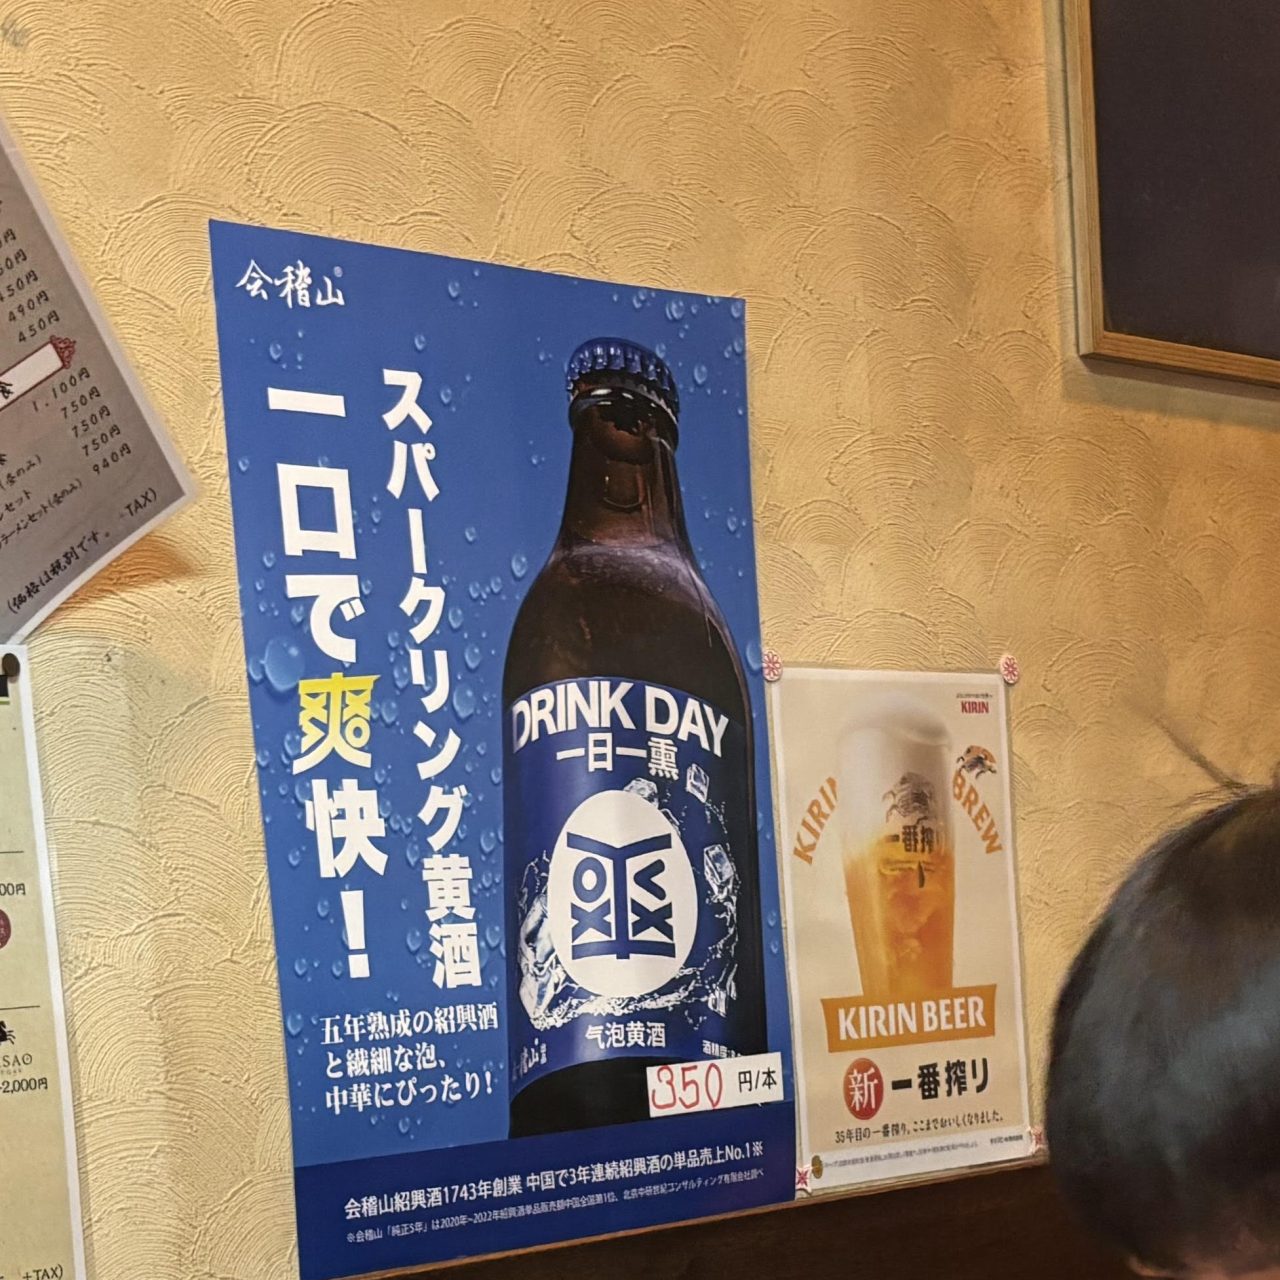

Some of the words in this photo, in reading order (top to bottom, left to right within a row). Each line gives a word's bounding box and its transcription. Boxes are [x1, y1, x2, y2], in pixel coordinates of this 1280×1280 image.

[9, 290, 49, 322] 490円
[19, 310, 60, 343] 450円
[61, 386, 101, 419] 750円
[72, 405, 111, 438] 750円
[82, 424, 121, 457] 750円
[93, 443, 131, 475] 940円
[266, 386, 389, 979] 一口で爽快！
[381, 368, 483, 989] スパークリング黄酒
[511, 679, 636, 755] DRINK
[644, 681, 730, 758] DAY
[961, 701, 989, 714] KIRIN
[953, 769, 1003, 854] BREW
[320, 1001, 498, 1045] 五年熟成の紹興酒
[585, 1021, 667, 1050] 气泡黄酒
[837, 1001, 918, 1041] KIRIN
[924, 995, 987, 1034] BEER
[326, 1041, 446, 1079] と繊細な泡、
[651, 1062, 723, 1110] 350
[738, 1067, 777, 1093] 円/本
[848, 1066, 879, 1112] 新
[891, 1056, 989, 1101] 一番搾り
